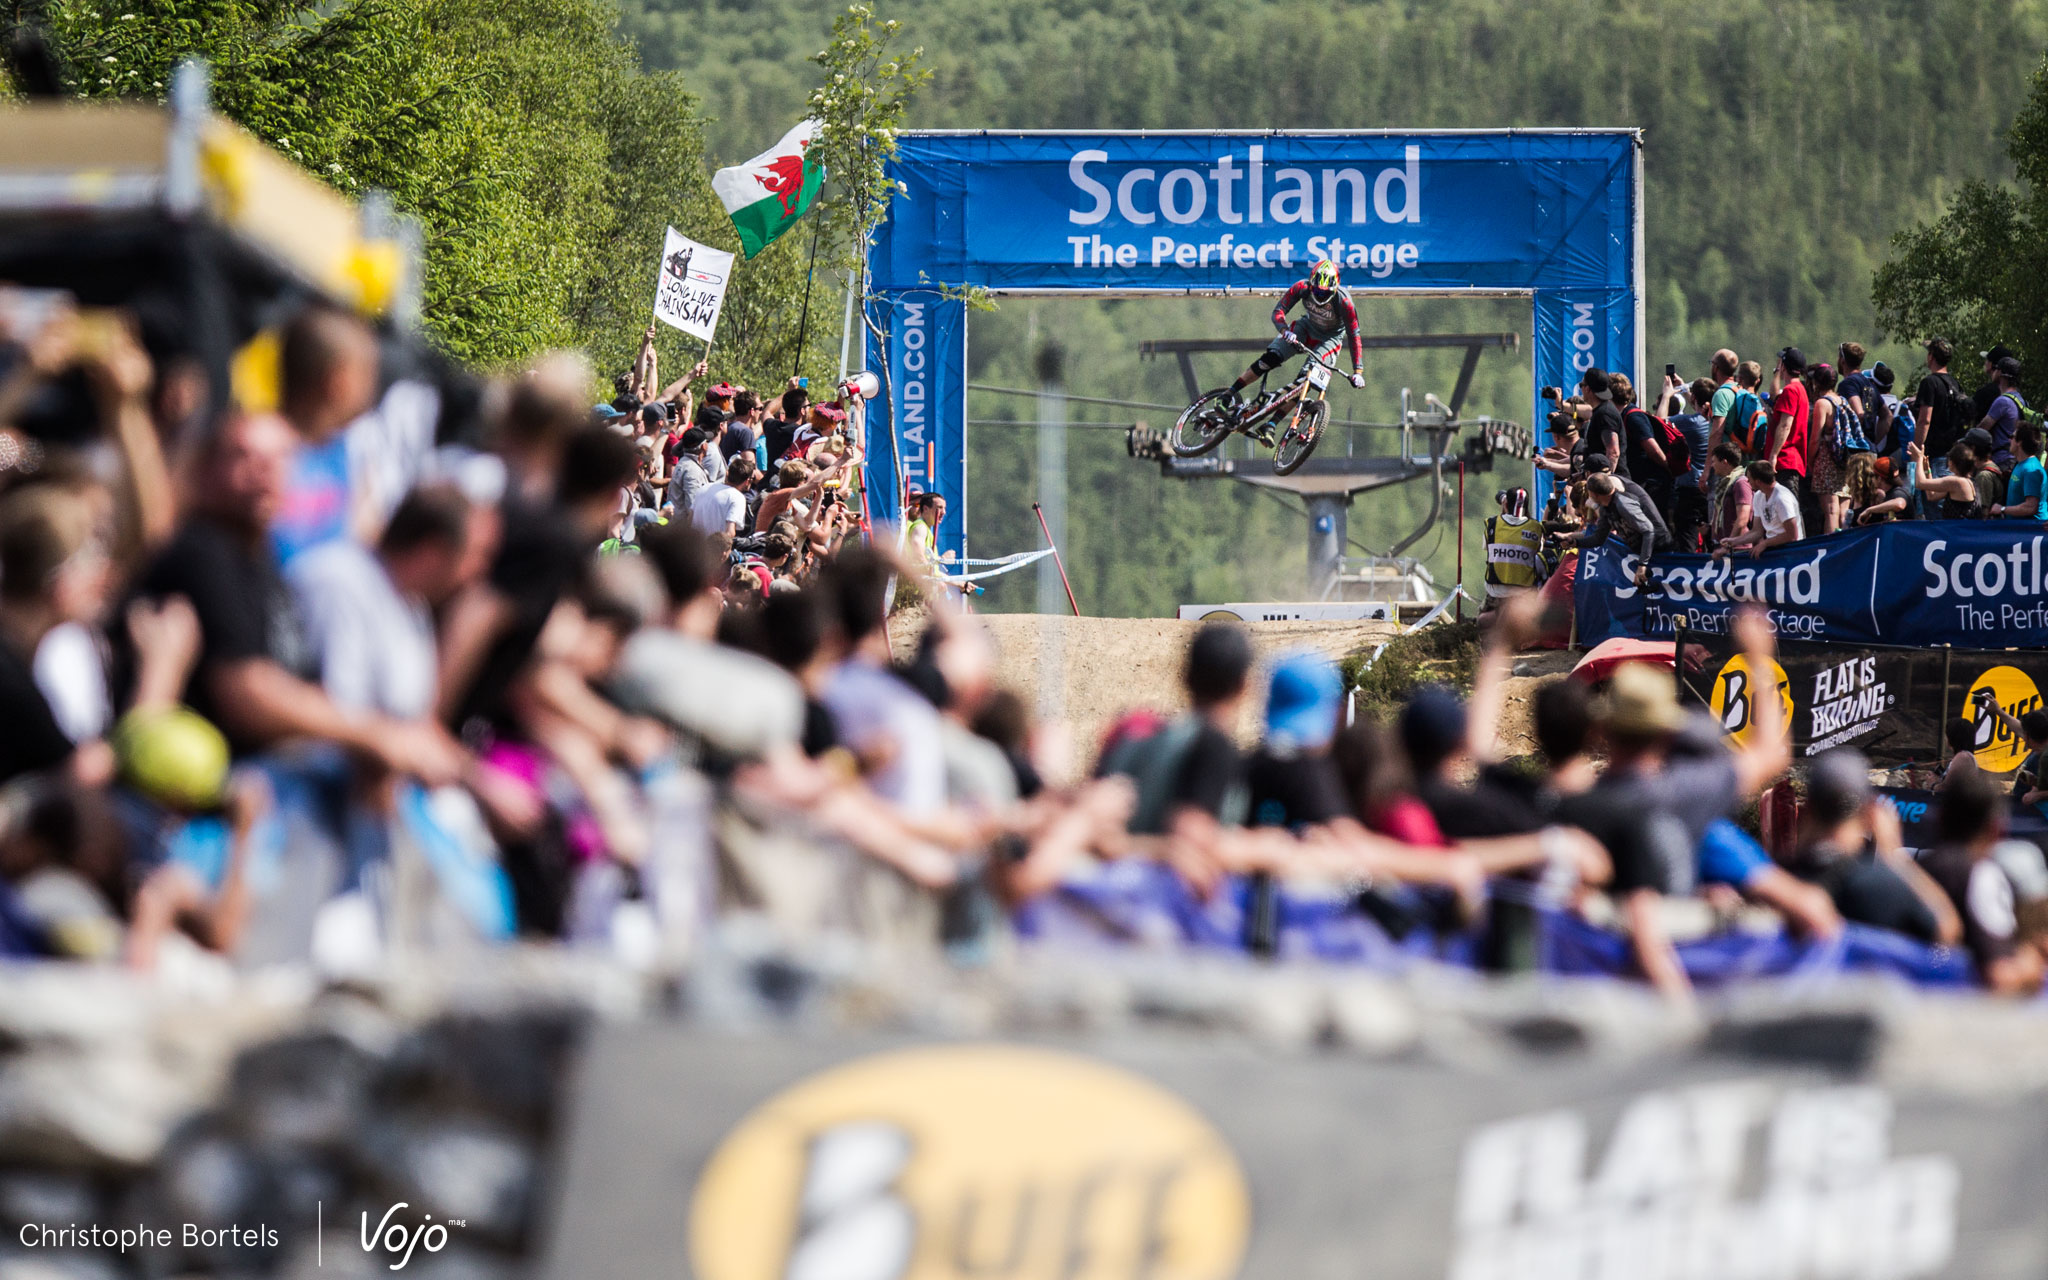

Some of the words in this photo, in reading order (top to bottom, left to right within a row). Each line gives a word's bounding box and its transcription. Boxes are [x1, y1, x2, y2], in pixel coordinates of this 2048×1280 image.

[1068, 144, 1421, 226] Scotland
[1067, 235, 1138, 268] The
[1152, 234, 1294, 269] Perfect
[1307, 236, 1419, 279] Stage
[667, 277, 690, 299] LONG
[691, 290, 718, 307] LIVE
[1572, 303, 1595, 396] COM
[1493, 548, 1530, 561] PHOTO
[1923, 535, 2048, 598] Scotl
[1688, 607, 1757, 634] Perf
[1766, 609, 1826, 640] Stage
[1955, 603, 1994, 631] The
[1813, 658, 1859, 705] FLAT
[1860, 656, 1876, 687] IS
[1811, 682, 1887, 738] BORING
